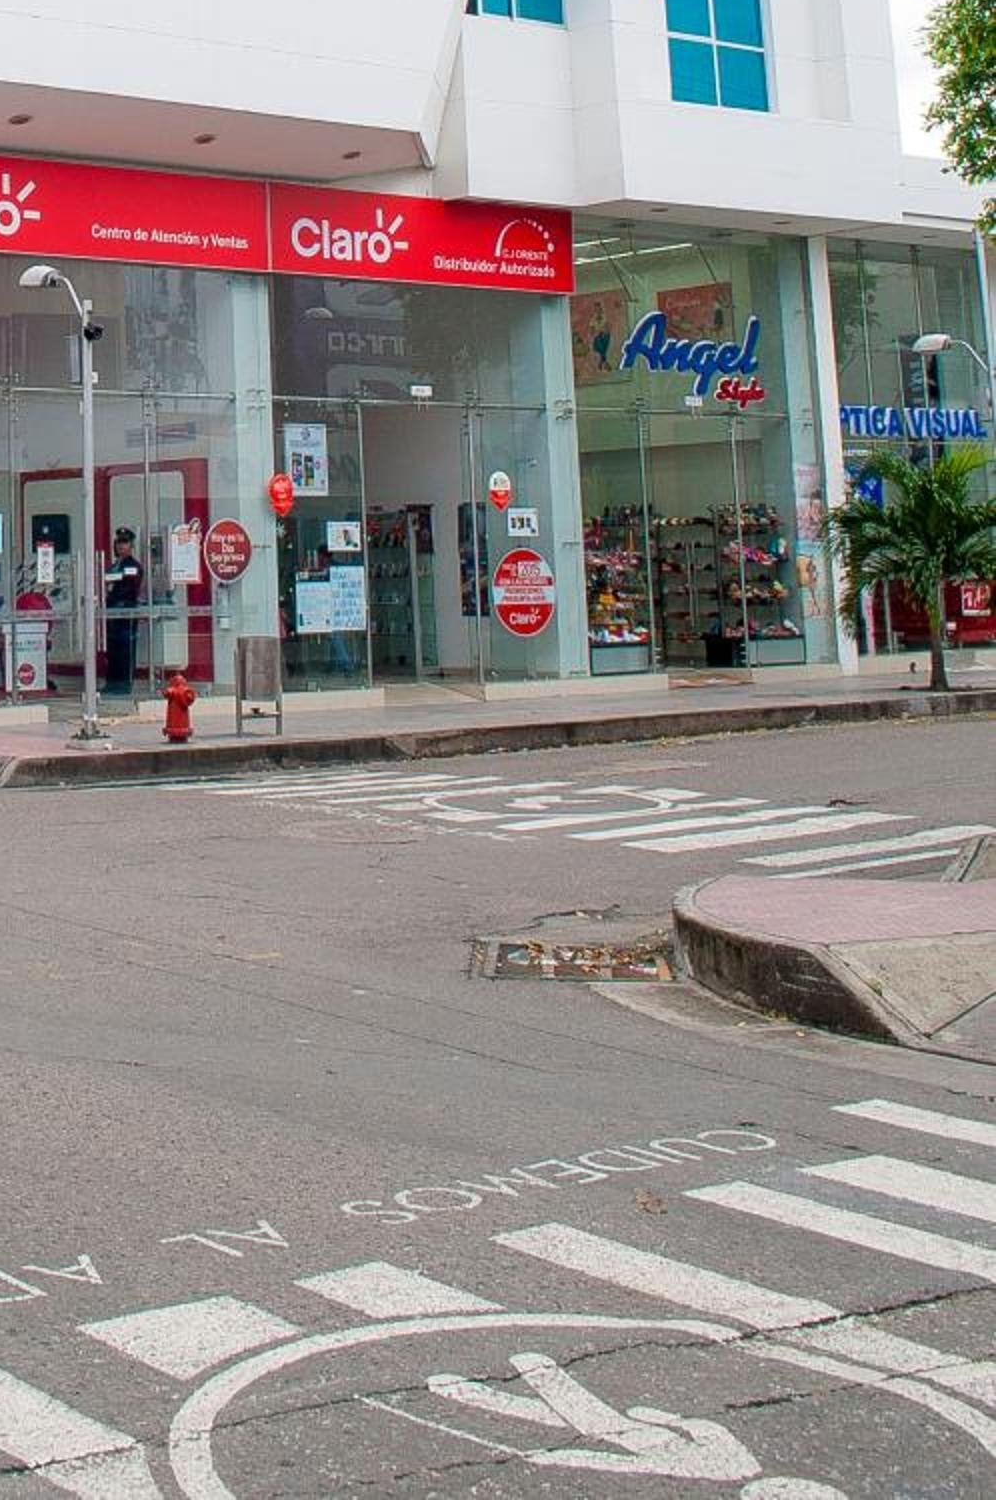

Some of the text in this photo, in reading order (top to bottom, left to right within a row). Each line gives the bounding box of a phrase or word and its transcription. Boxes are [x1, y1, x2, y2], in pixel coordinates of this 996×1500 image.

[91, 224, 249, 250] Centro de Atención y Ventas
[291, 217, 393, 263] Claro
[434, 255, 555, 278] Distribuidor Autorizado
[619, 311, 761, 396] Angel
[714, 376, 766, 411] Style
[839, 404, 988, 439] PTICA VISUAL
[509, 612, 537, 625] Claro
[340, 1129, 777, 1225] CUIDEMOS
[160, 1219, 291, 1258] AL
